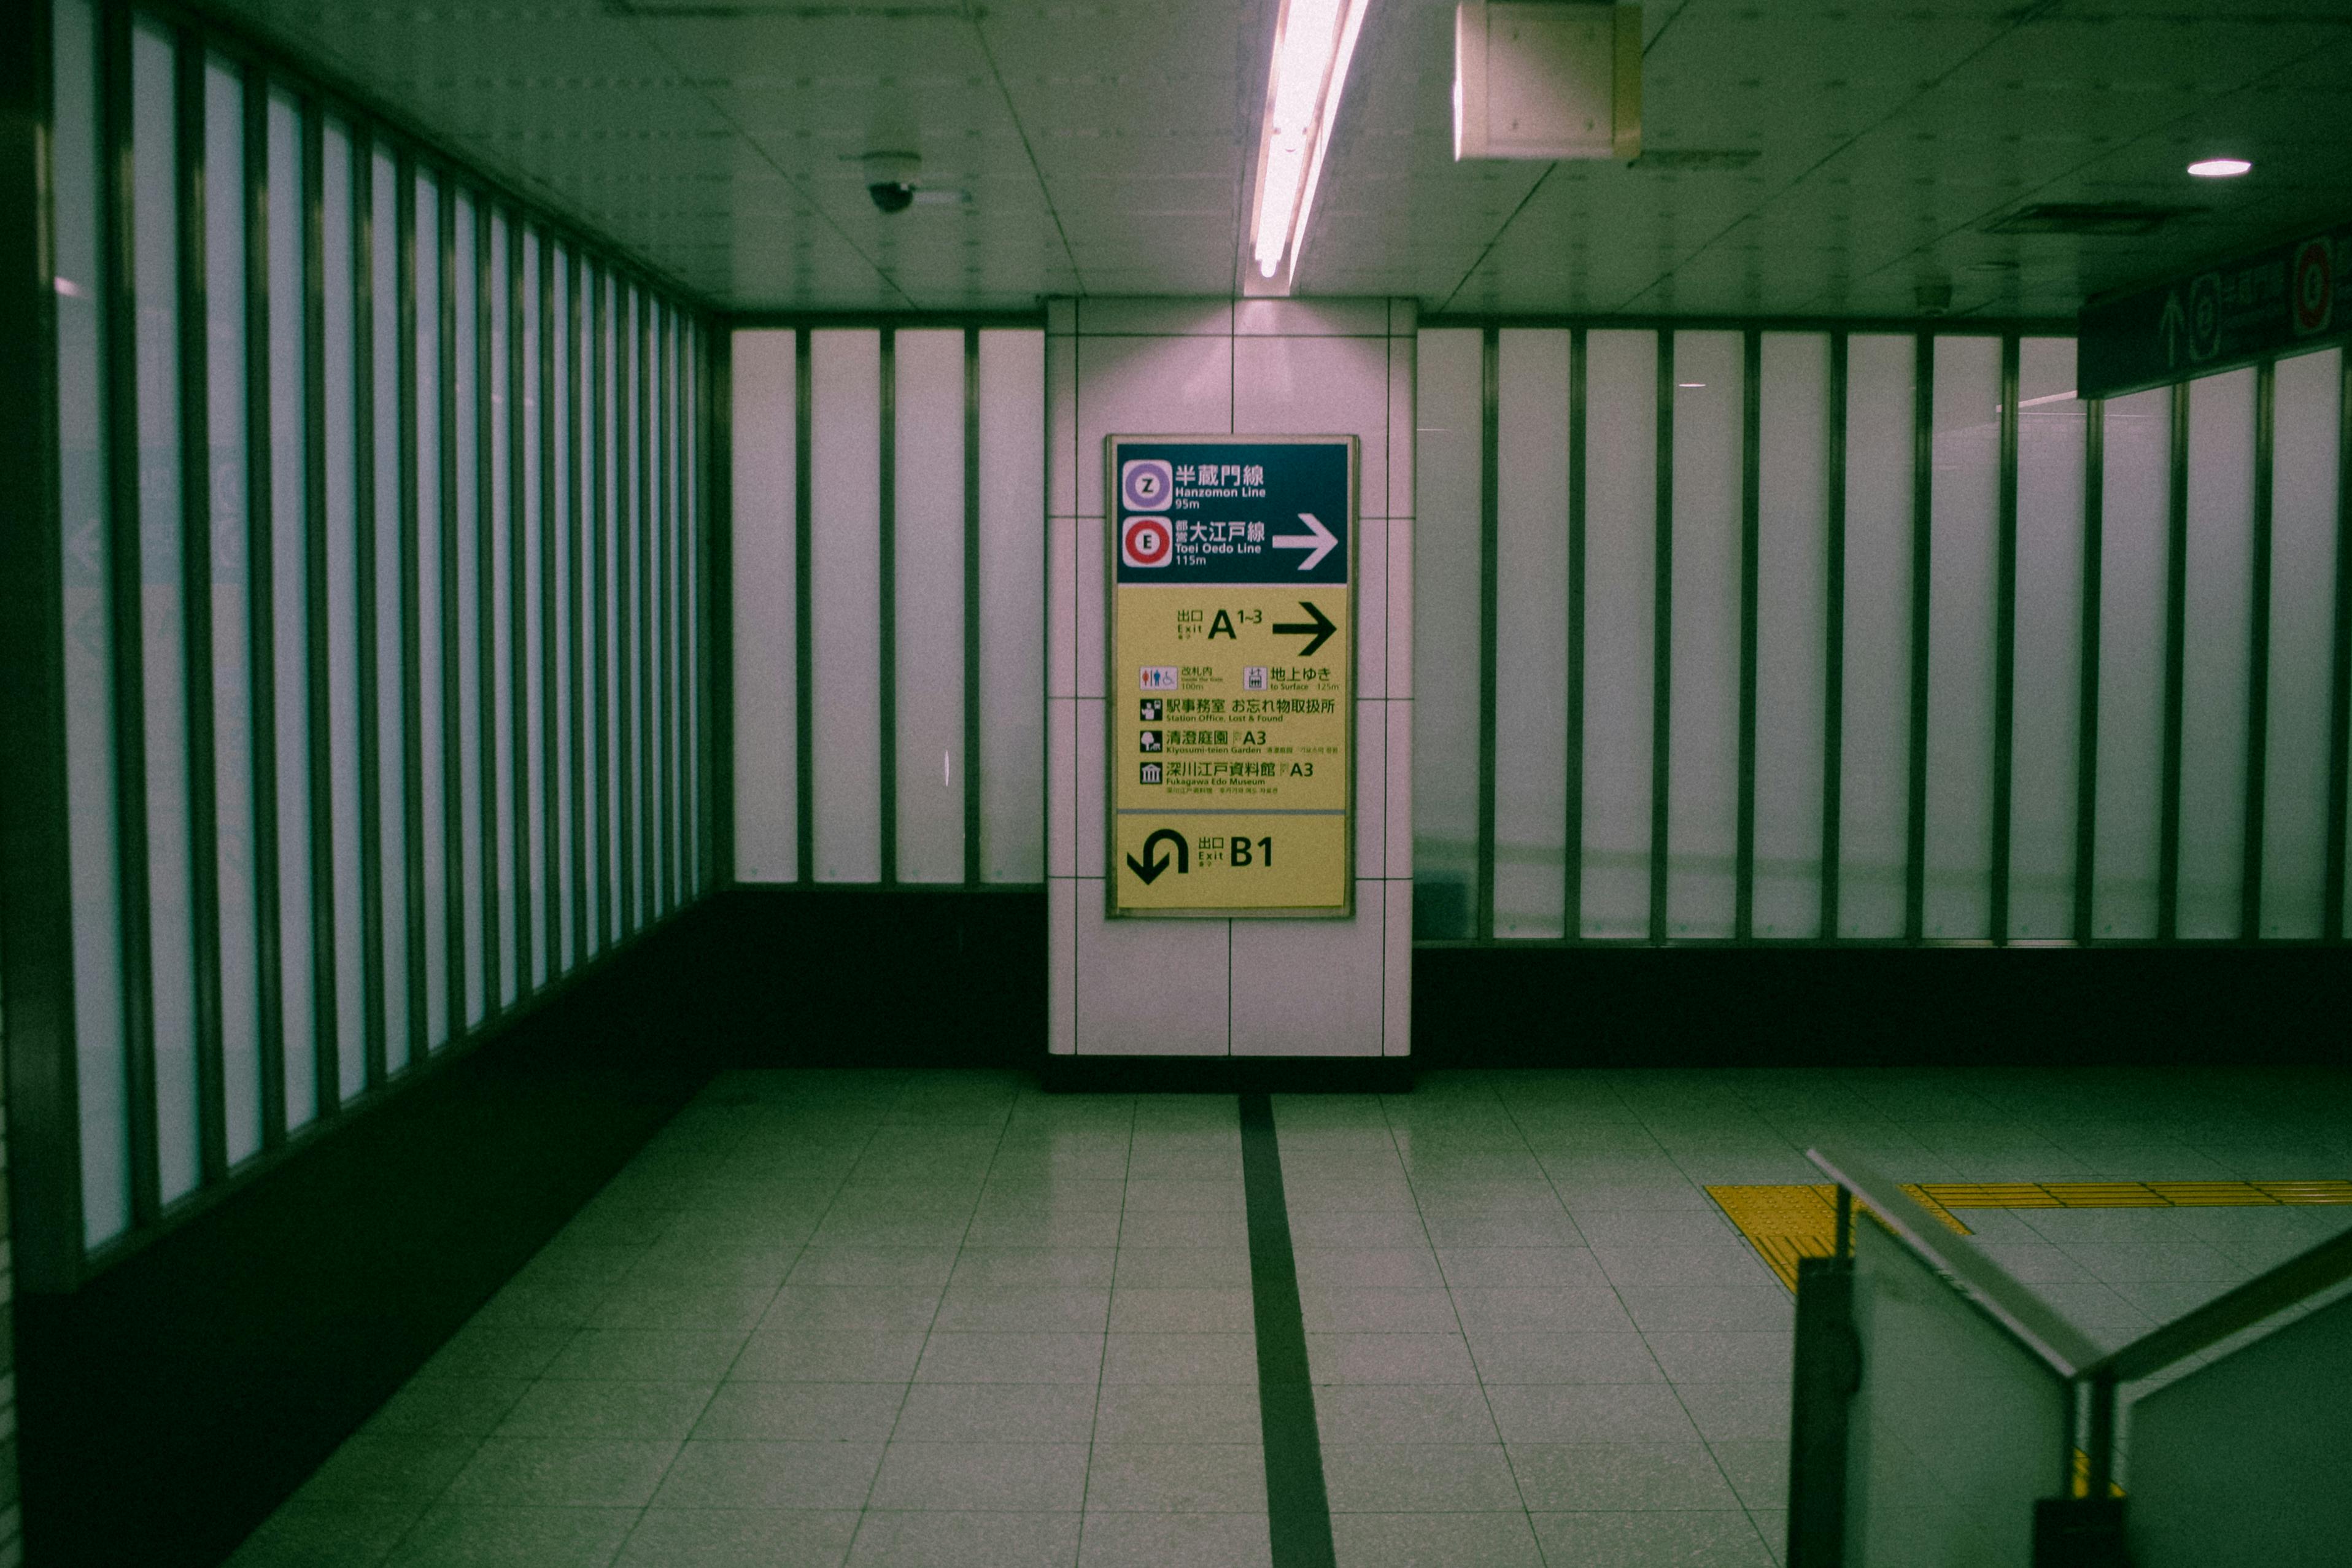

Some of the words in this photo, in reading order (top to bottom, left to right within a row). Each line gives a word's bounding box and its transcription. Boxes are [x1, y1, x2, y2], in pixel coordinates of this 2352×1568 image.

[1175, 465, 1264, 487] 半蔵門線
[1142, 479, 1154, 493] Z
[1175, 487, 1238, 498] Hanzomon
[1242, 487, 1266, 498] Line
[1175, 499, 1199, 509] 95m
[1142, 535, 1152, 549] E
[1175, 543, 1198, 554] Toei
[1202, 543, 1234, 554] Oedo
[1237, 543, 1261, 554] Line
[1176, 555, 1206, 565] 115m
[1178, 609, 1202, 622] 出口
[1178, 624, 1202, 633] Exit
[1182, 666, 1212, 676] 改札内
[1271, 667, 1331, 681] 地上ゆき
[1167, 698, 1225, 713] 駅事務室
[1232, 698, 1335, 713] お忘れ物取扱所
[1167, 730, 1228, 744] 清澄庭園
[1244, 732, 1266, 744] A3
[1167, 762, 1275, 776] 深川江戸資料館
[1290, 763, 1313, 776] A3
[1199, 837, 1224, 849] 出口
[1199, 851, 1223, 860] Exit
[1231, 836, 1272, 867] B1
